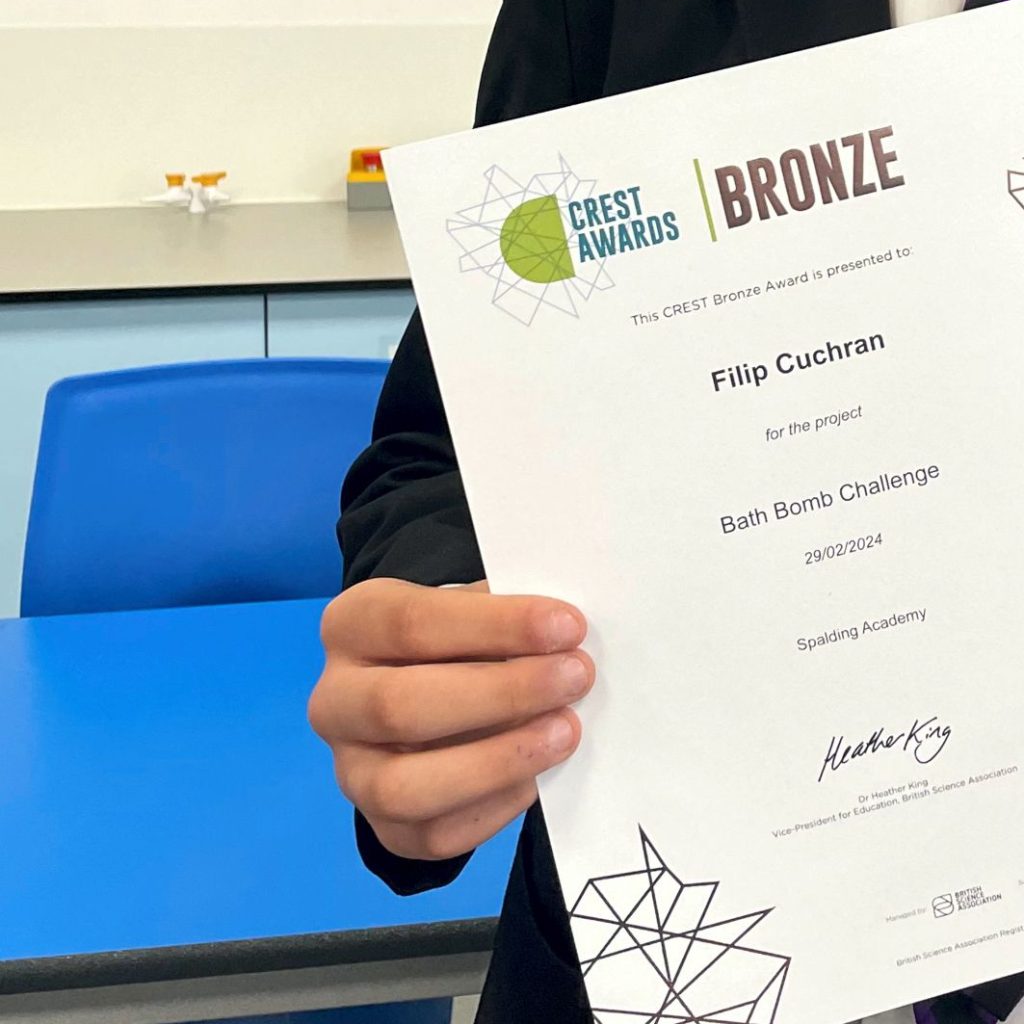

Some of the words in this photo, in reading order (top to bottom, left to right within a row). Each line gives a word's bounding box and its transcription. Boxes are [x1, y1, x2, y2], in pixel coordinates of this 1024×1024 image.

[714, 125, 905, 229] BRONZE
[568, 186, 643, 231] CREST
[578, 211, 680, 263] AWARDS
[630, 311, 659, 326] This
[662, 297, 708, 319] CREST
[713, 285, 761, 307] Bronze
[765, 272, 809, 293] Award
[812, 268, 823, 281] is
[826, 249, 893, 279] presented
[896, 246, 914, 259] to:
[711, 363, 768, 392] Filip
[775, 332, 886, 375] Cuchran
[765, 427, 785, 442] for
[788, 419, 811, 436] the
[815, 405, 863, 432] project
[720, 507, 769, 534] Bath
[773, 490, 834, 520] Bomb
[839, 464, 940, 502] Challenge
[804, 532, 883, 565] 29/02/2024
[796, 625, 859, 652] Spalding
[862, 607, 928, 635] Academy
[818, 727, 905, 782] Heather
[903, 716, 952, 764] King
[771, 814, 838, 838] Vice-President
[838, 809, 852, 821] for
[853, 797, 901, 817] Education,
[902, 787, 931, 803] British
[931, 779, 966, 795] Science
[968, 765, 1019, 785] Association
[858, 794, 869, 804] Dr
[871, 784, 907, 801] Heather
[908, 778, 930, 792] King
[954, 885, 982, 899] BRITISH
[956, 891, 985, 905] SCIENCE
[957, 893, 1002, 912] ASSOCIATION
[896, 954, 922, 967] British
[922, 944, 953, 959] Science
[954, 932, 999, 950] Association
